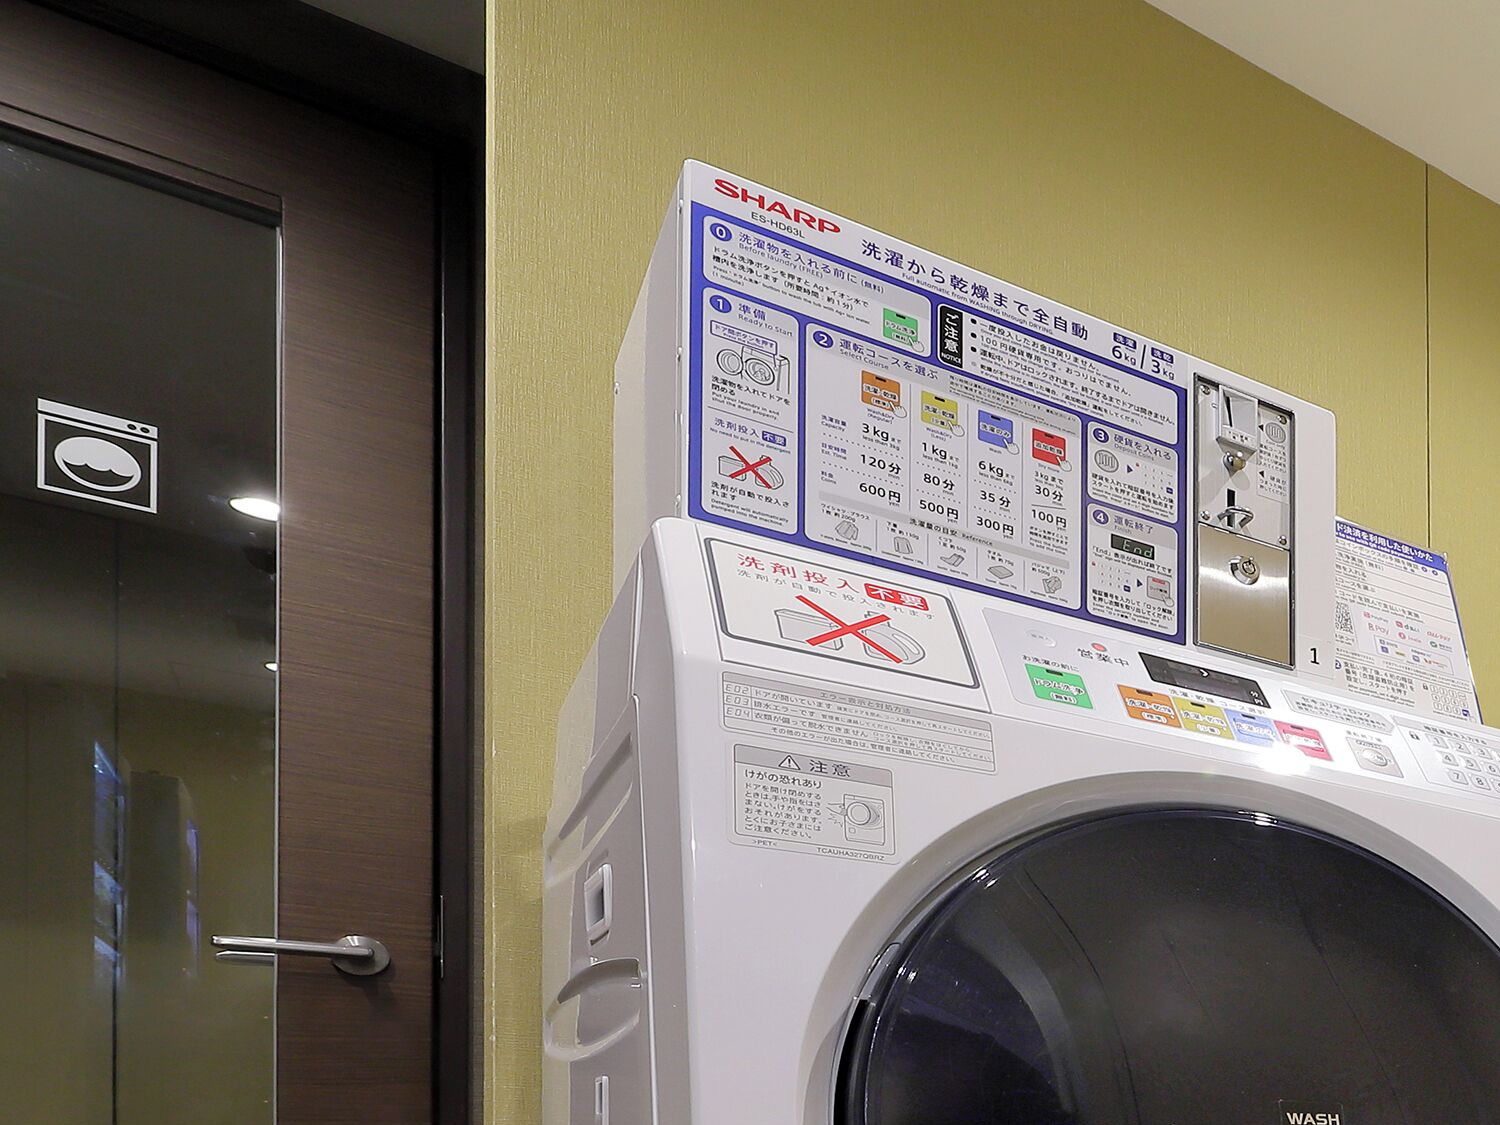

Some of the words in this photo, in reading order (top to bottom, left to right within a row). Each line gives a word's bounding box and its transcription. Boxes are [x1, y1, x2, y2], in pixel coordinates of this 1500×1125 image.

[714, 178, 842, 234] SHARP
[750, 210, 805, 239] ES-HD63L
[712, 244, 811, 288] ドラム洗浄ボタンを押すと
[738, 241, 764, 257] Before
[766, 252, 798, 270] laundry
[738, 231, 858, 285] 洗濯物を入れる前に
[860, 237, 1088, 341] 洗濯から乾燥まで全自動
[902, 272, 914, 282] Full
[916, 277, 950, 296] automatic
[951, 290, 967, 303] from
[968, 297, 1000, 315] WASHING
[1001, 310, 1027, 326] through
[738, 302, 766, 322] 準備
[738, 313, 763, 328] Ready
[764, 321, 772, 330] to
[773, 325, 793, 337] Start
[944, 311, 959, 354] ご注意
[818, 333, 828, 346] 2
[839, 337, 938, 381] 運転コースを選ぶ
[839, 348, 861, 362] Select
[863, 356, 889, 371] Course
[941, 351, 961, 364] NOTICE
[711, 374, 790, 407] 洗濯物を入れてドアを
[713, 416, 759, 439] 洗剤投入
[1097, 429, 1105, 441] 3
[1113, 432, 1171, 461] 硬貨を入れる
[860, 452, 901, 476] 120分
[858, 480, 901, 504] 600円
[923, 471, 955, 492] 80分
[710, 480, 790, 510] 洗剤が自動で投入さ
[710, 488, 737, 503] れます
[979, 489, 1011, 509] 35分
[1034, 483, 1063, 502] 30分
[918, 498, 958, 521] 500円
[1031, 508, 1066, 528] 100円
[1096, 511, 1104, 522] 4
[975, 514, 1014, 536] 300円
[1113, 514, 1153, 535] 運転終了
[1122, 538, 1153, 559] End
[736, 552, 860, 594] 洗剤投入
[867, 585, 926, 610] 不要
[736, 568, 936, 621] 洗剤が自動で投入されます
[1310, 648, 1319, 664] 1
[725, 682, 749, 695] E02
[725, 694, 749, 706] E03
[725, 706, 750, 719] E04
[744, 768, 822, 789] けがの恐れあり
[809, 758, 850, 778] 注意
[744, 782, 821, 799] ドアを開け閉めする
[744, 807, 822, 824] おそれがあります。
[744, 815, 821, 831] とくにお子さまには
[744, 823, 812, 839] ご注意ください。
[1287, 1112, 1340, 1125] WASH
